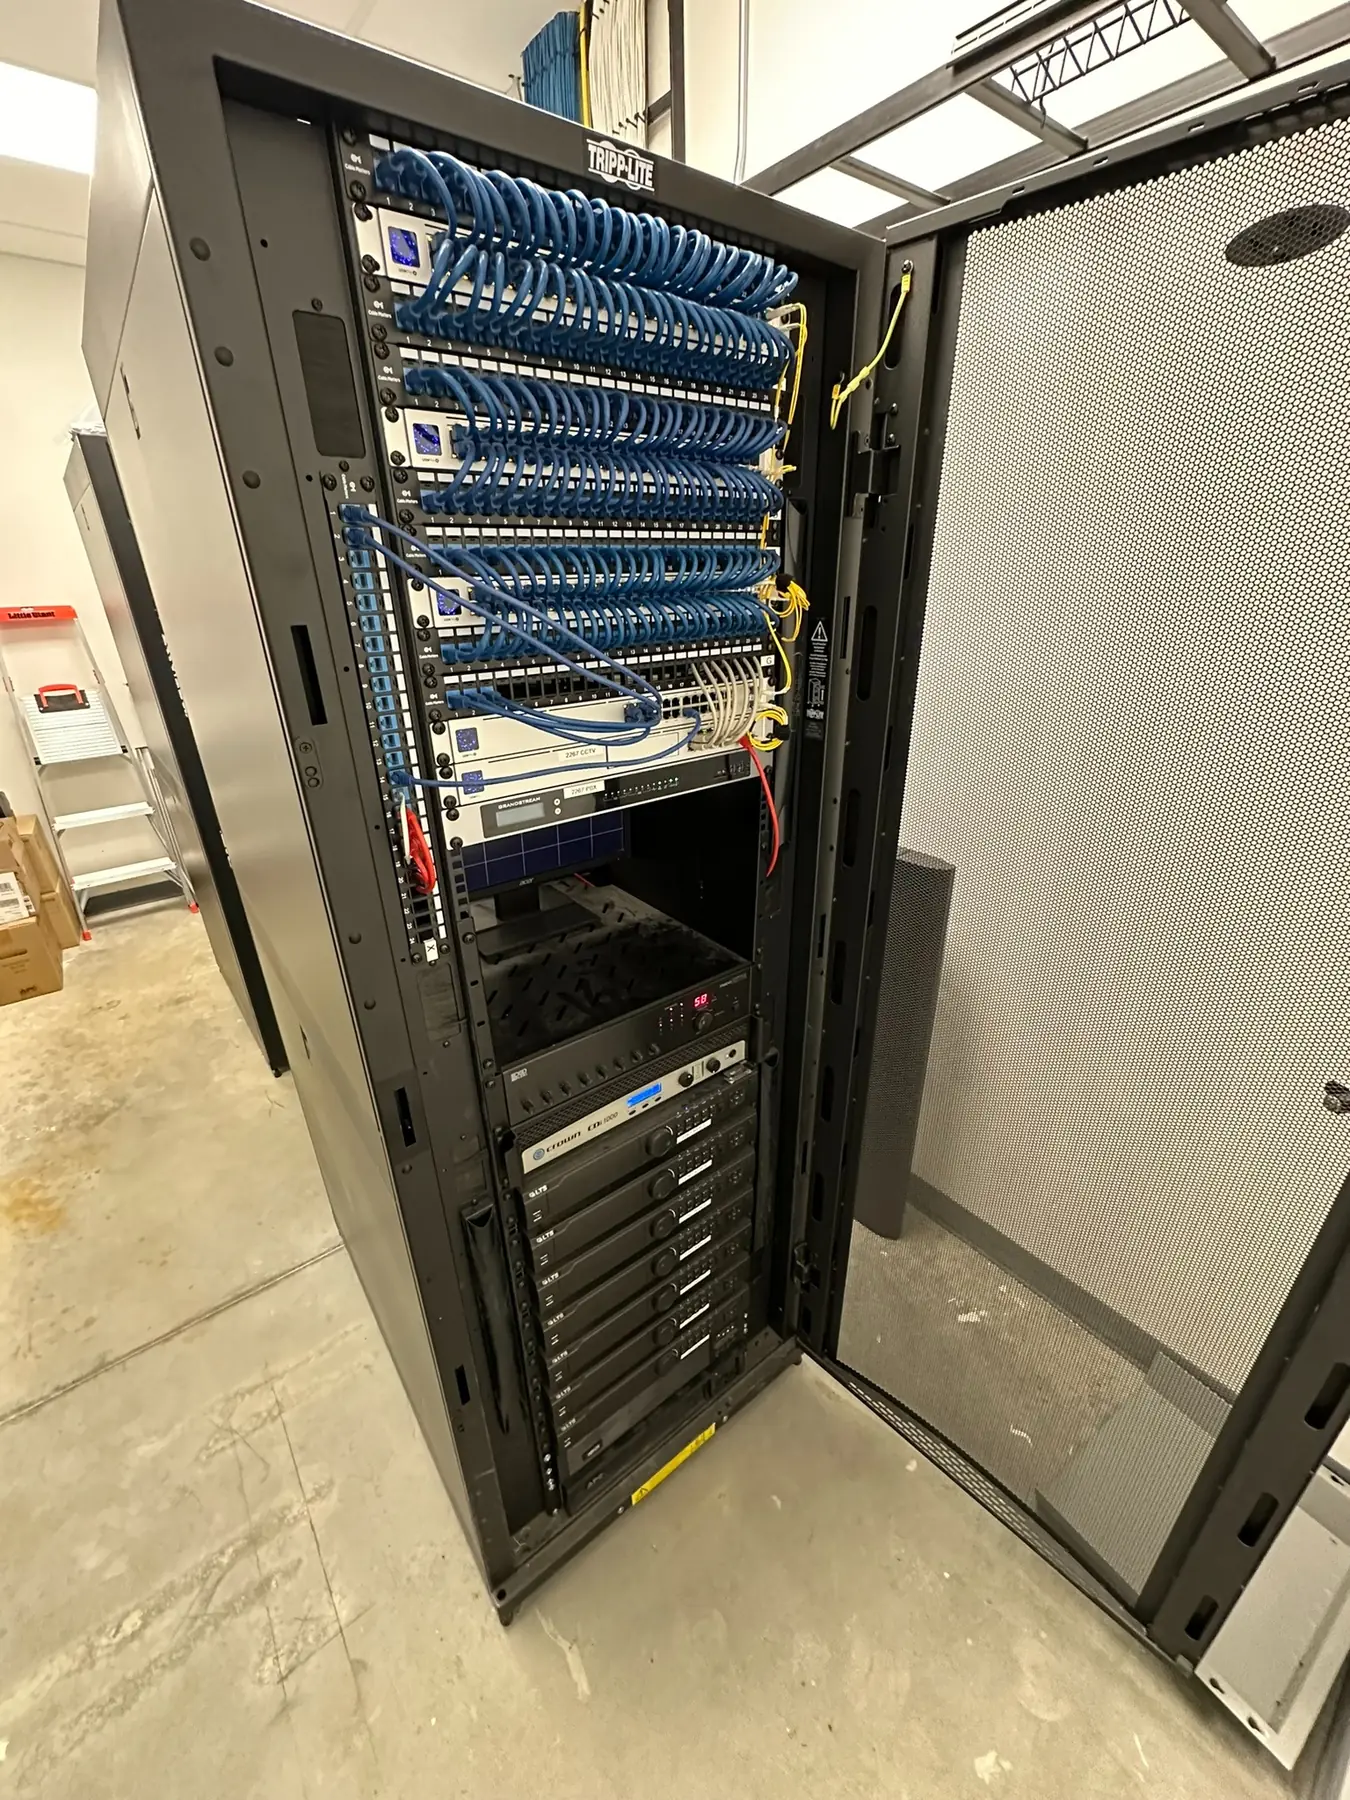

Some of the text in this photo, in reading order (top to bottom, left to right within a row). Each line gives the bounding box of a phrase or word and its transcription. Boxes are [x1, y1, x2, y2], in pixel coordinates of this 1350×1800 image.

[386, 197, 436, 217] 1 2 3
[565, 748, 596, 758] 2267 CCTV
[498, 797, 541, 809] GRANDSTREAM
[694, 993, 708, 1007] 58
[546, 1131, 581, 1153] crown
